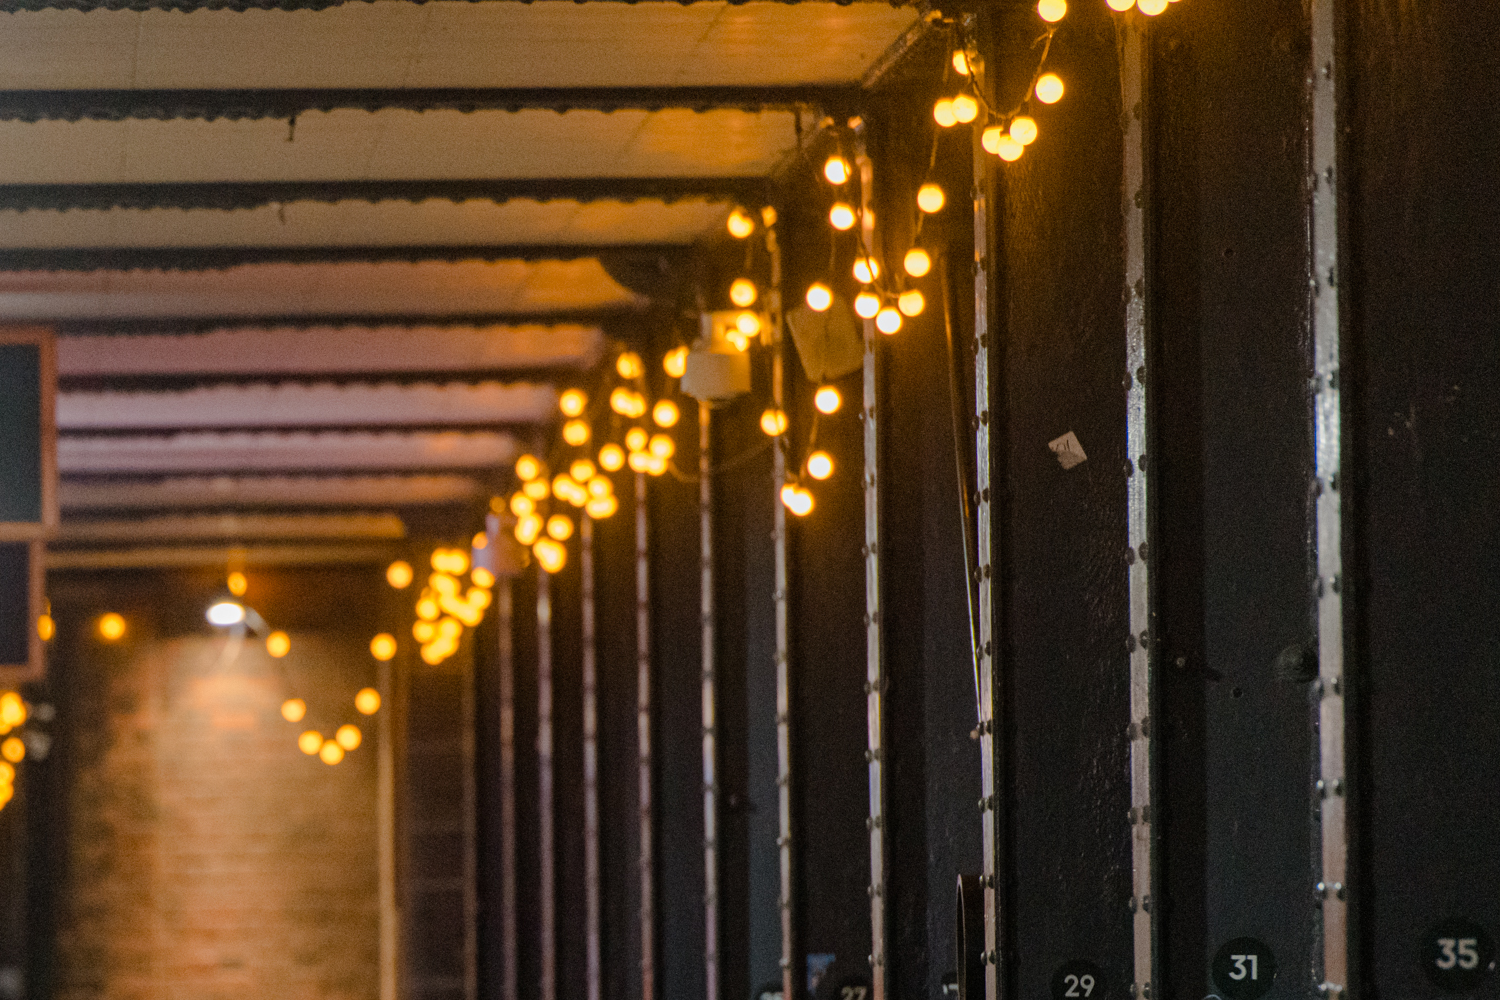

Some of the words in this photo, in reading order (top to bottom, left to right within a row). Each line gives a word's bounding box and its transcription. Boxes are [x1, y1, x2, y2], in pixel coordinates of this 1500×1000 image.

[1435, 937, 1480, 970] 35
[1228, 954, 1258, 981] 31
[1063, 974, 1096, 998] 29
